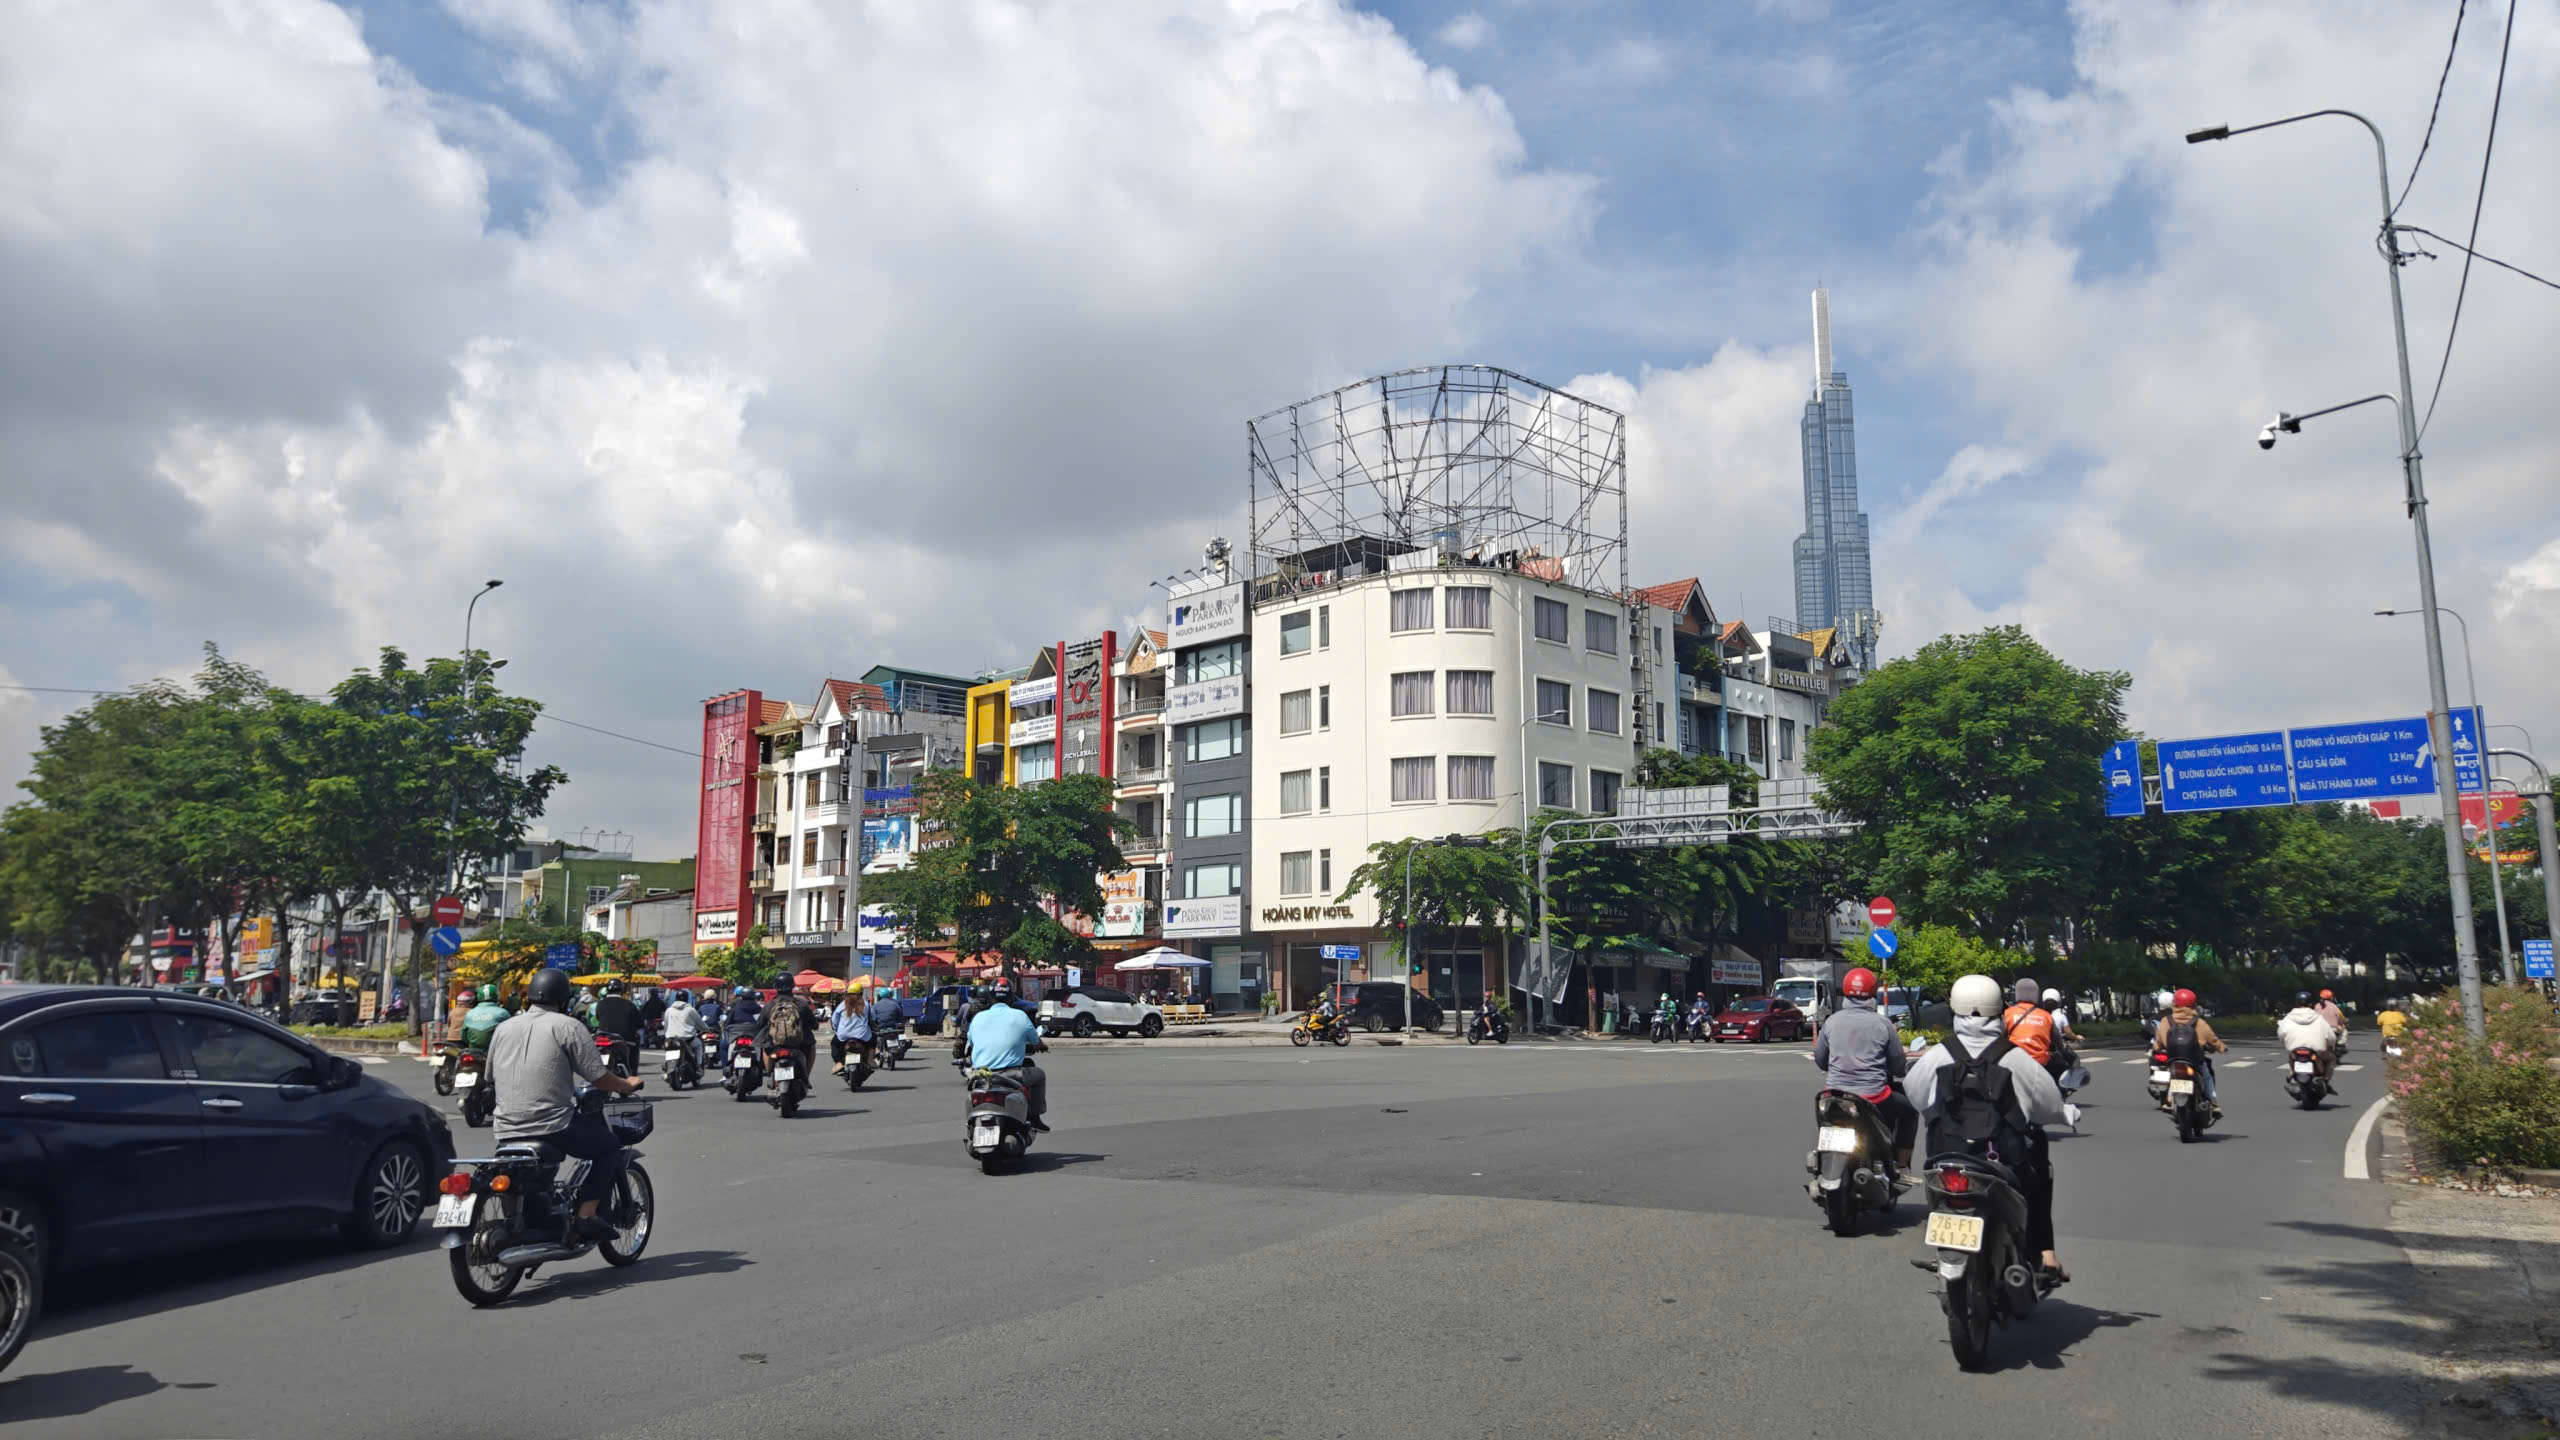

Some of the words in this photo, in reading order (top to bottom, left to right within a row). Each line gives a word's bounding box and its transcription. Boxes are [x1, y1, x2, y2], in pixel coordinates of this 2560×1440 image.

[1193, 604, 1234, 622] PARKWAY
[1778, 672, 1795, 685] SPA
[2295, 735, 2323, 748] ĐƯỜNG
[2325, 734, 2336, 746] VÕ
[2370, 729, 2390, 741] GIÁP
[2399, 731, 2413, 739] Km
[2271, 742, 2283, 751] Km
[839, 720, 852, 804] HOTEL
[2297, 757, 2314, 769] CẦU
[2315, 756, 2328, 768] SÀI
[2329, 754, 2347, 766] GÒN
[2400, 752, 2415, 761] Km
[2179, 768, 2205, 779] ĐƯỜNG
[2206, 764, 2226, 777] QUỐC
[2227, 765, 2254, 776] HƯƠNG
[2270, 763, 2283, 772] Km
[2300, 779, 2316, 791] NGÃ
[2317, 779, 2328, 789] TƯ
[2330, 776, 2353, 788] HÀNG
[2354, 777, 2377, 787] XANH
[2404, 774, 2418, 783] Km
[2182, 790, 2199, 802] CHỢ
[2199, 786, 2218, 798] THẢO
[2272, 784, 2286, 793] Km
[1181, 910, 1217, 923] PARKWAY
[1262, 904, 1301, 922] HOÀNG
[1303, 906, 1322, 921] MY
[1322, 905, 1354, 919] HOTEL
[789, 935, 804, 945] SALA
[805, 934, 824, 944] HOTEL
[1937, 1216, 1973, 1232] 76-F1
